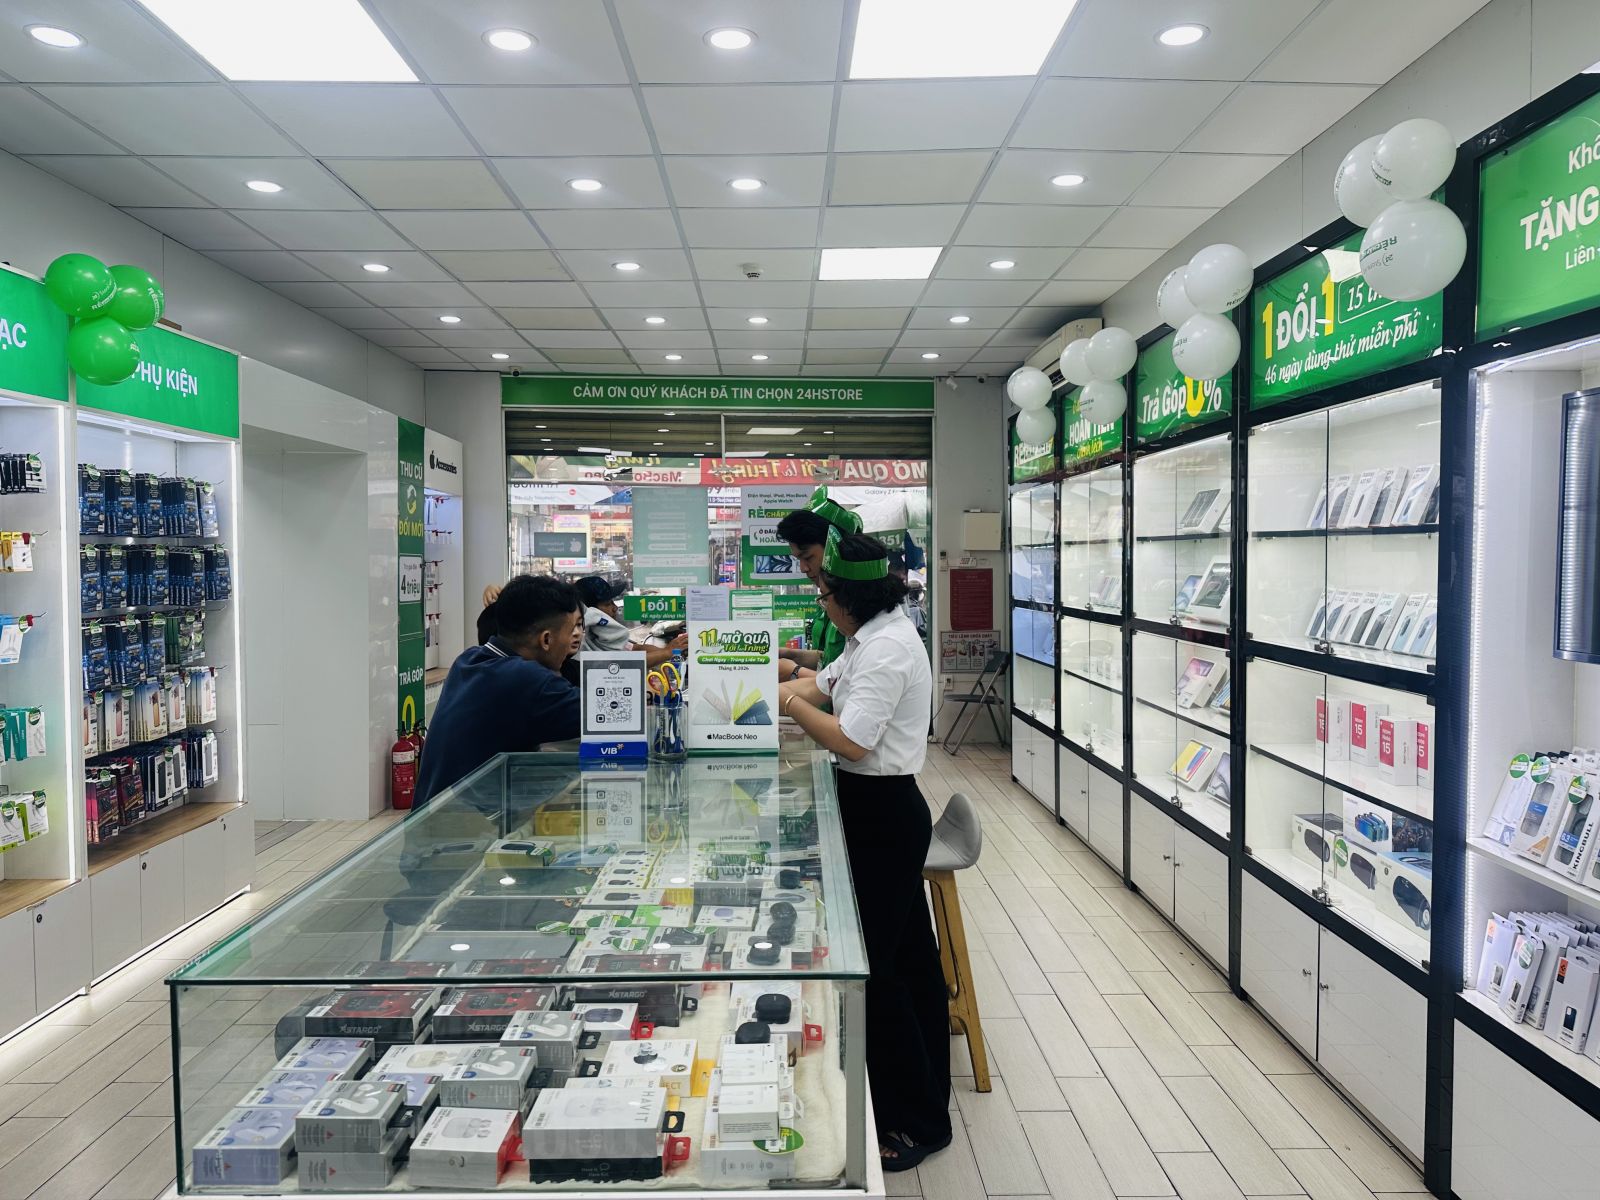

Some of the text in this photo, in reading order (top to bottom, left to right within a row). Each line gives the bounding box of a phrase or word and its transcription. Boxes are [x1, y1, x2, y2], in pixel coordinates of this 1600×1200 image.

[1520, 185, 1600, 251] TẶNG
[1565, 244, 1595, 270] Liên
[1262, 271, 1364, 360] 1 ĐỔI 1 15
[1264, 307, 1421, 386] 46 ngày dùng thử miễn phí
[166, 368, 198, 398] KIỆN
[573, 382, 863, 402] CẢM ƠN QUÝ KHÁCH ĐÃ TIN CHỌN 24HSTORE
[1143, 387, 1160, 424] Trả
[1161, 379, 1186, 419] Góp
[399, 460, 423, 480] THU CŨ
[435, 457, 458, 475] Accessories
[748, 506, 765, 519] RẺ
[398, 520, 424, 537] ĐỔI MỚI
[400, 574, 421, 597] 4 triệu
[639, 597, 646, 613] 1
[669, 598, 677, 613] 1
[698, 628, 770, 648] 11 MỞ QUÀ
[399, 666, 424, 686] TRẢ GÓP
[712, 733, 743, 741] MacBook
[1354, 723, 1363, 735] 15
[600, 747, 618, 755] VIB
[1382, 742, 1391, 755] 15
[634, 1090, 656, 1124] HAVIT
